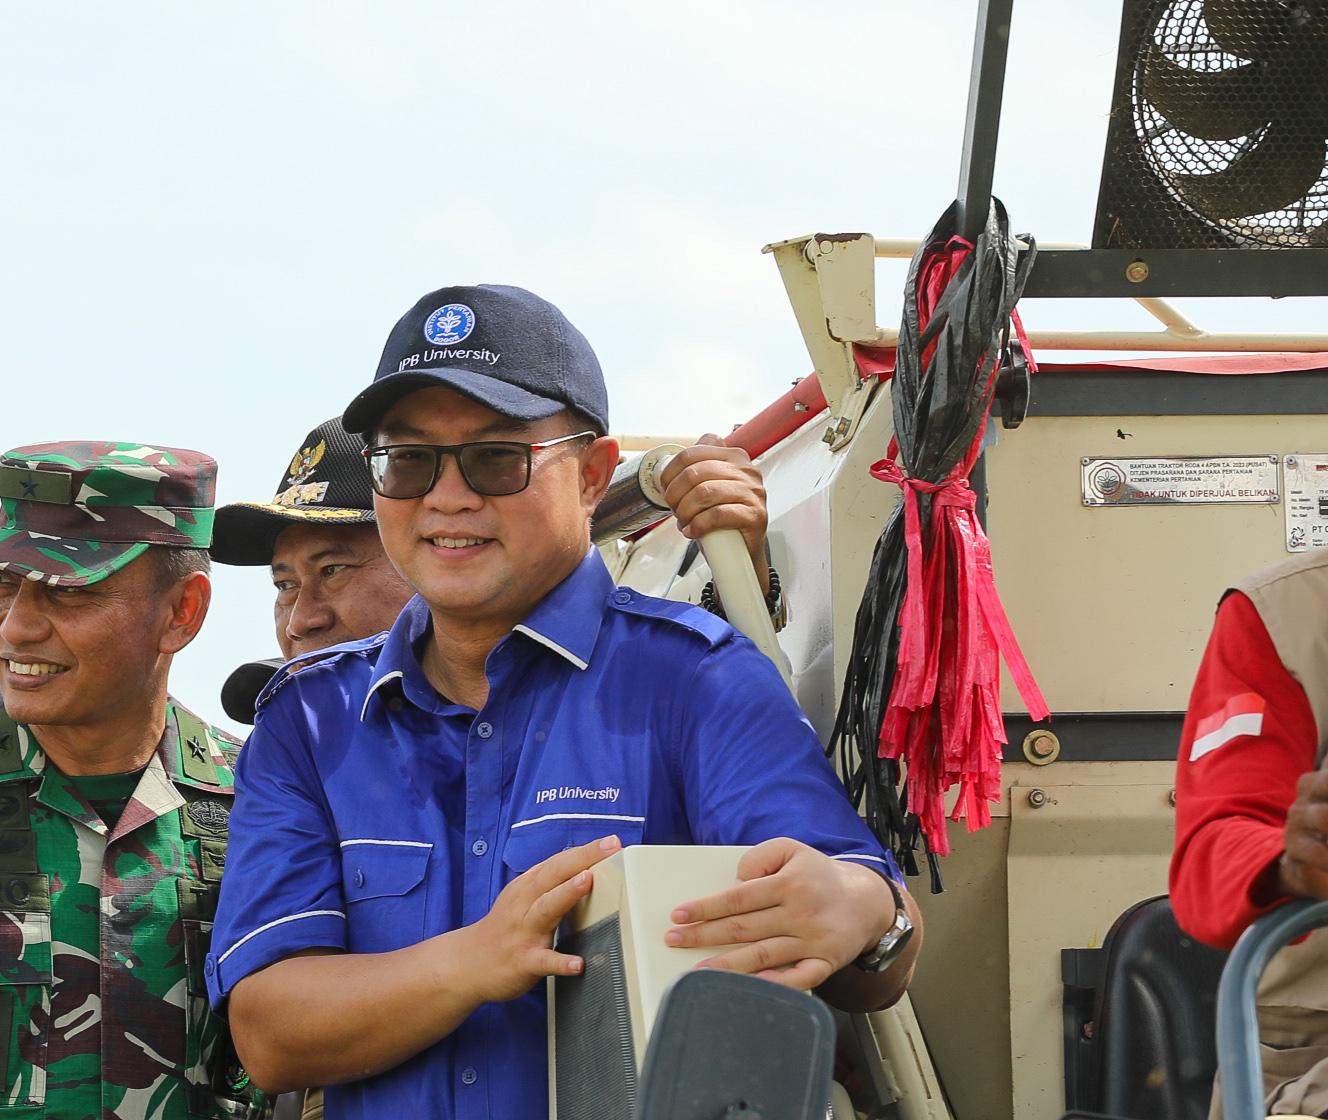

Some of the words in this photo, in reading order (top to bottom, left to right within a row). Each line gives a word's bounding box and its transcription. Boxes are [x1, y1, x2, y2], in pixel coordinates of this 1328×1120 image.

[398, 353, 420, 372] IPB
[423, 347, 501, 365] University
[1158, 490, 1188, 498] UNTUK
[1189, 489, 1236, 498] DIPERJUAL
[1238, 488, 1275, 497] BELIKAN
[1312, 525, 1323, 533] PT
[536, 788, 557, 803] IPB
[558, 786, 621, 803] University
